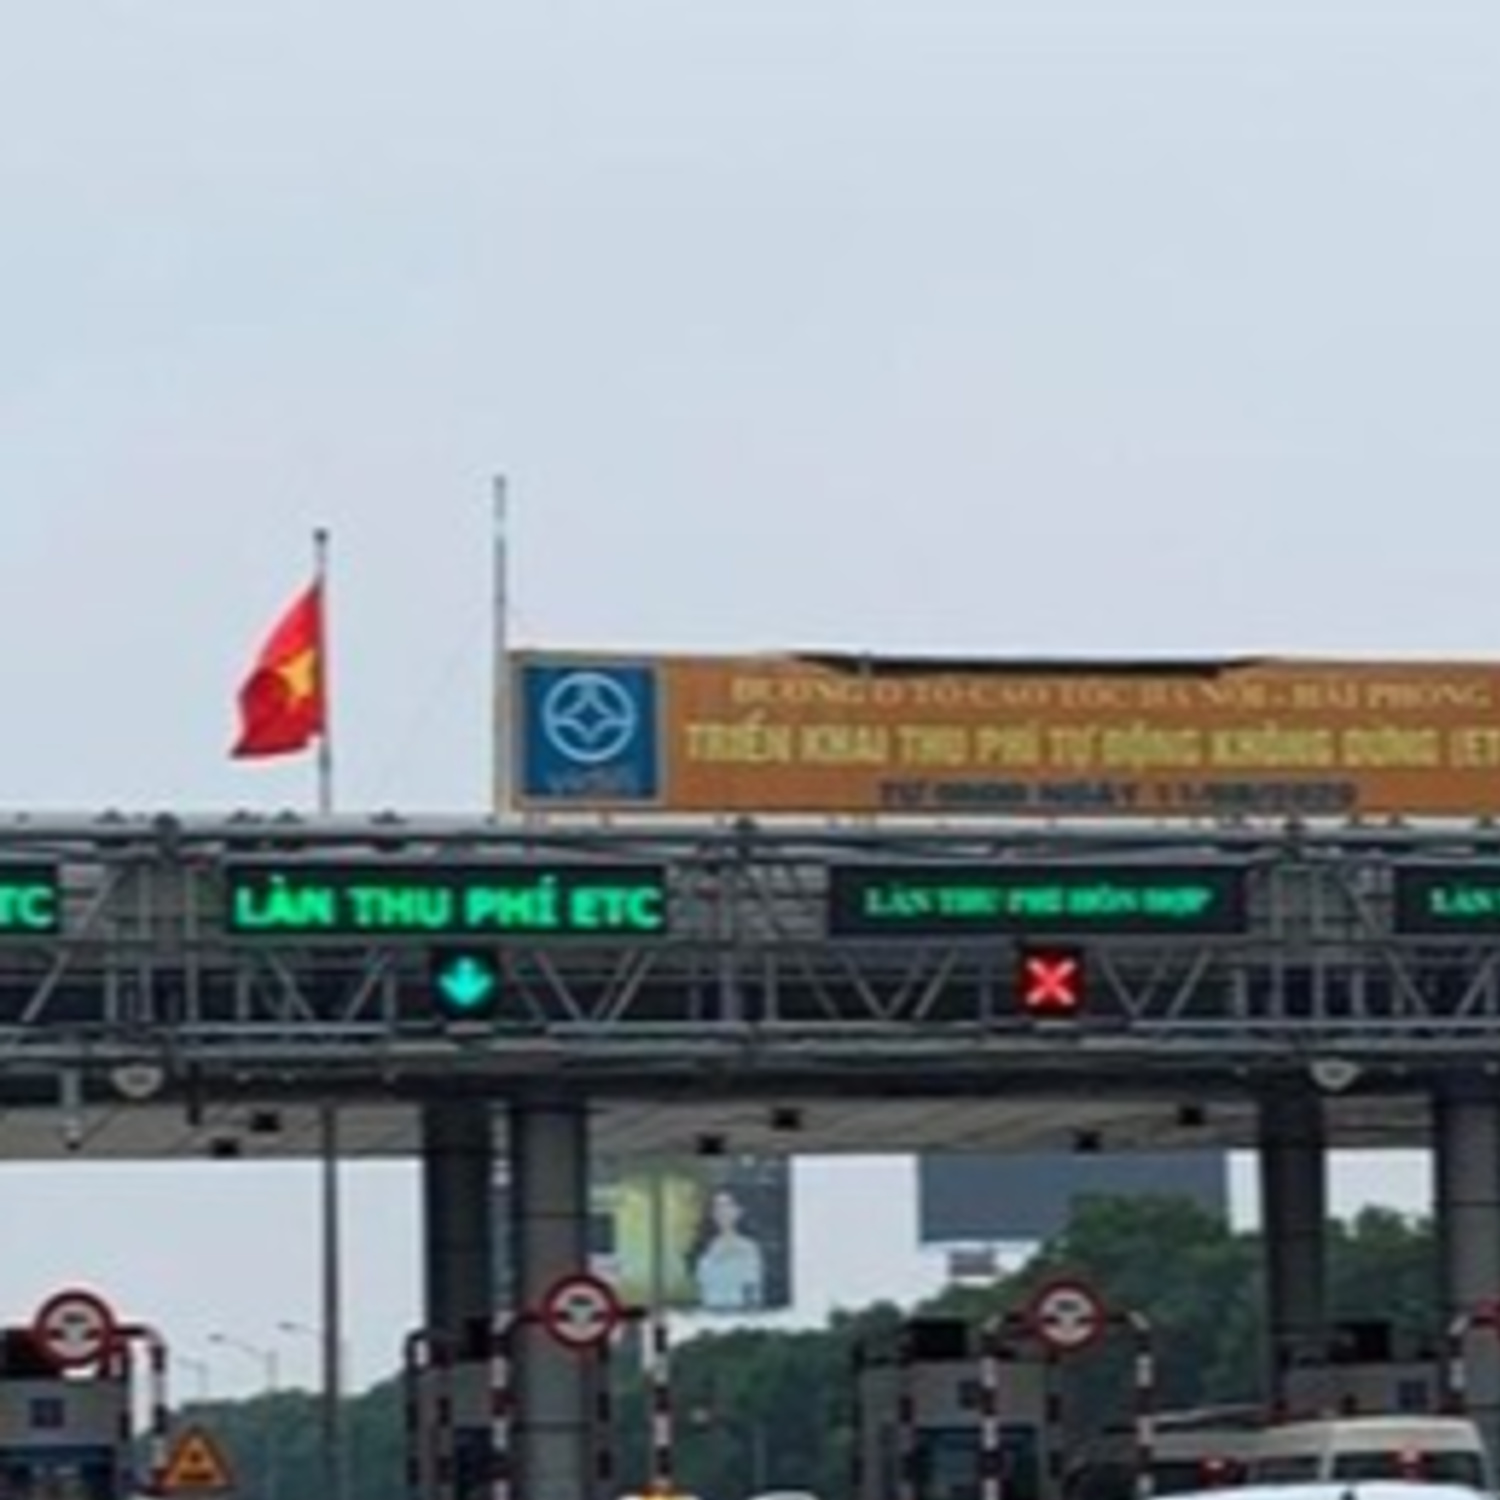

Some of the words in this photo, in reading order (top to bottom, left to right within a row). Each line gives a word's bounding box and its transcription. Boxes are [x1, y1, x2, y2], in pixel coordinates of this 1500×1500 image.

[235, 874, 333, 926] LÀN
[347, 888, 450, 926] THU
[466, 874, 558, 926] PHÍ
[570, 888, 663, 927] ETC
